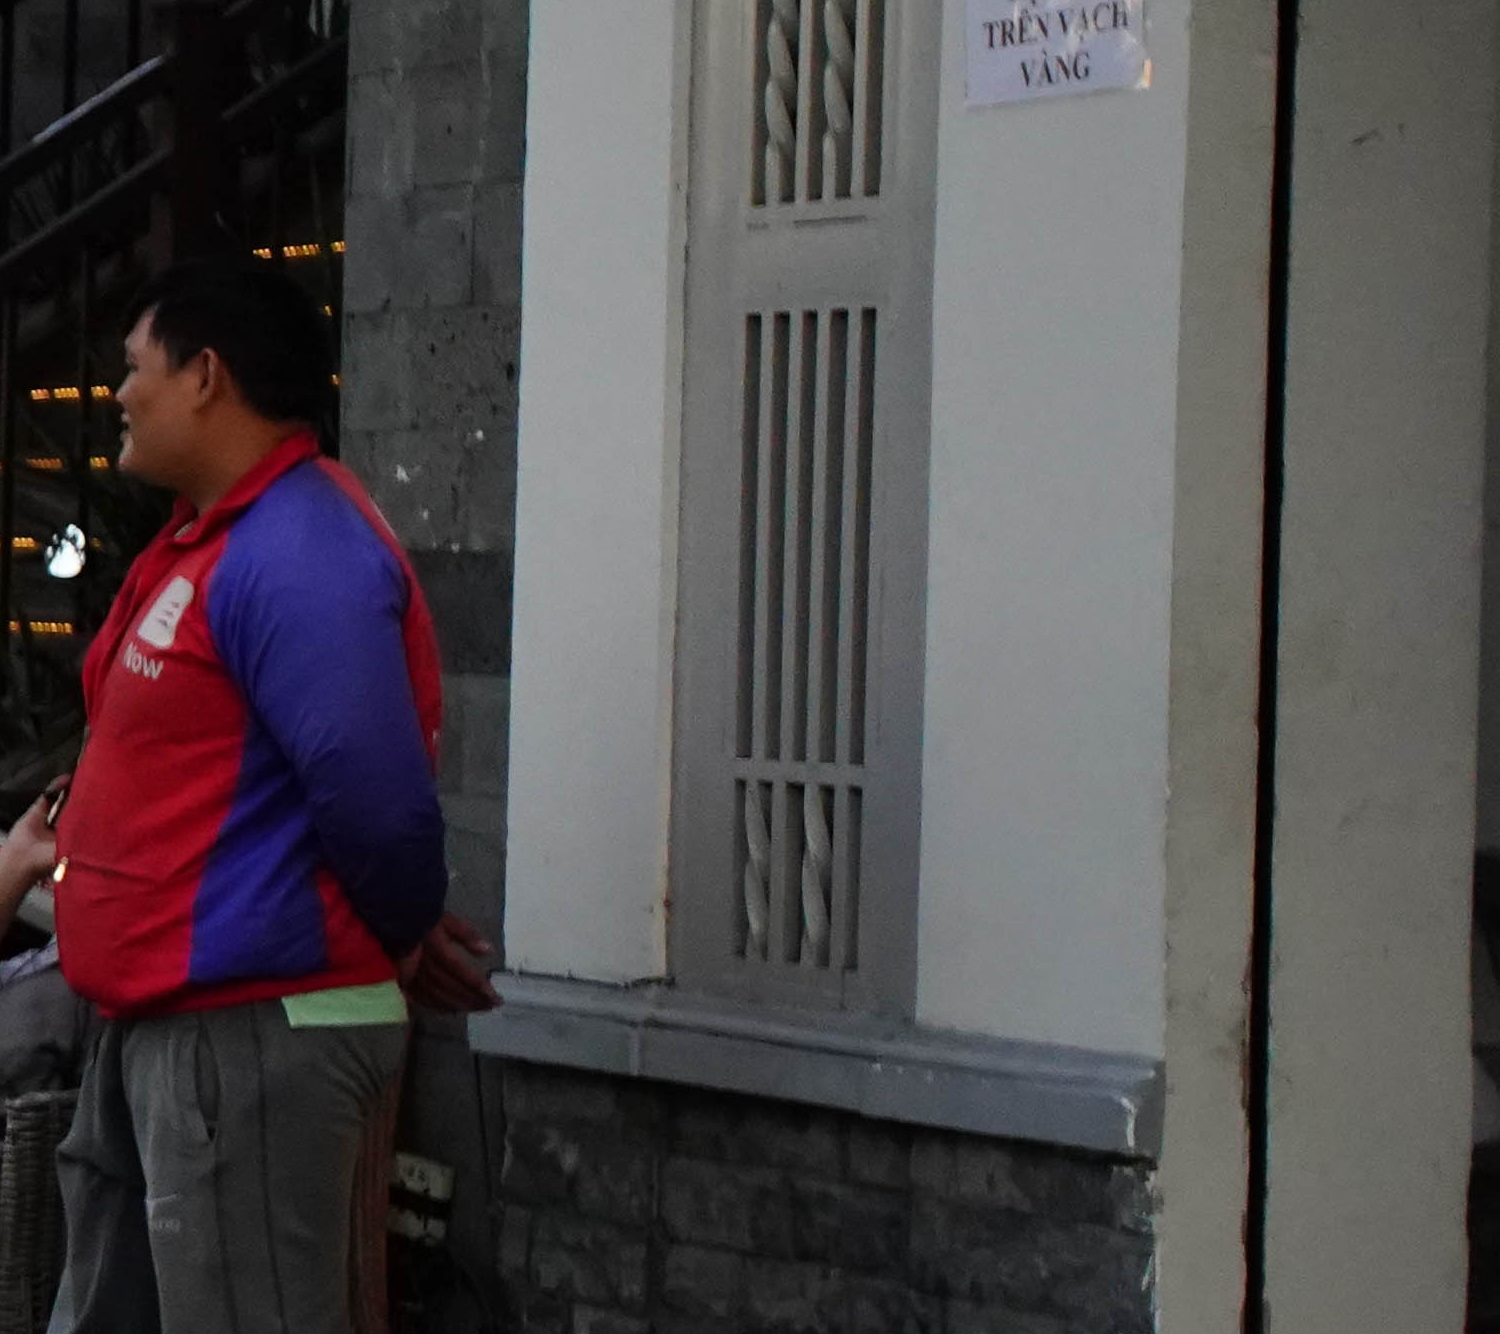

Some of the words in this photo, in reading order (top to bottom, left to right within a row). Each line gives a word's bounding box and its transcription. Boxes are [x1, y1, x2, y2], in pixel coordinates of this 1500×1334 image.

[981, 8, 1050, 50] TRÊN
[1020, 49, 1091, 88] VÀNG
[122, 641, 164, 681] Now
